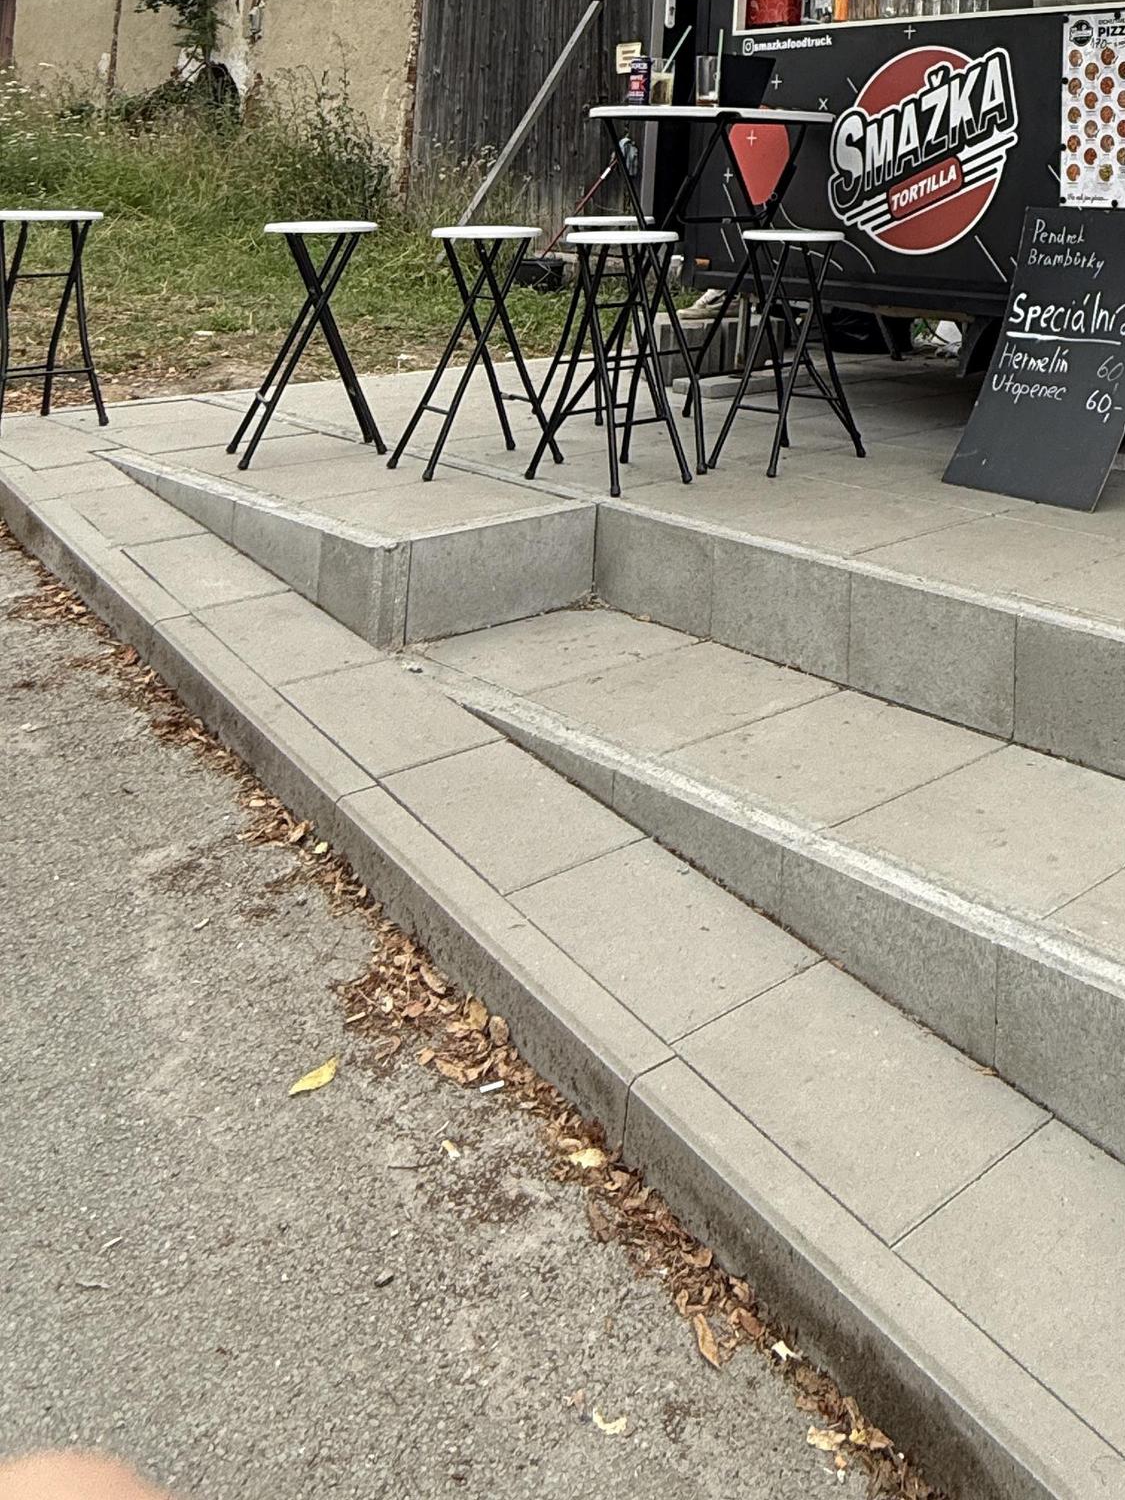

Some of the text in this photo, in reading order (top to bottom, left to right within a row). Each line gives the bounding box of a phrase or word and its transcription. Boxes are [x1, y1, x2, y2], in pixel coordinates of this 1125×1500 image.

[753, 34, 832, 52] smazkafoodtruck
[831, 51, 1013, 210] SMAŽKA
[890, 164, 958, 212] TORTILLA
[998, 341, 1070, 374] Hermelín
[992, 373, 1068, 404] Utopenec
